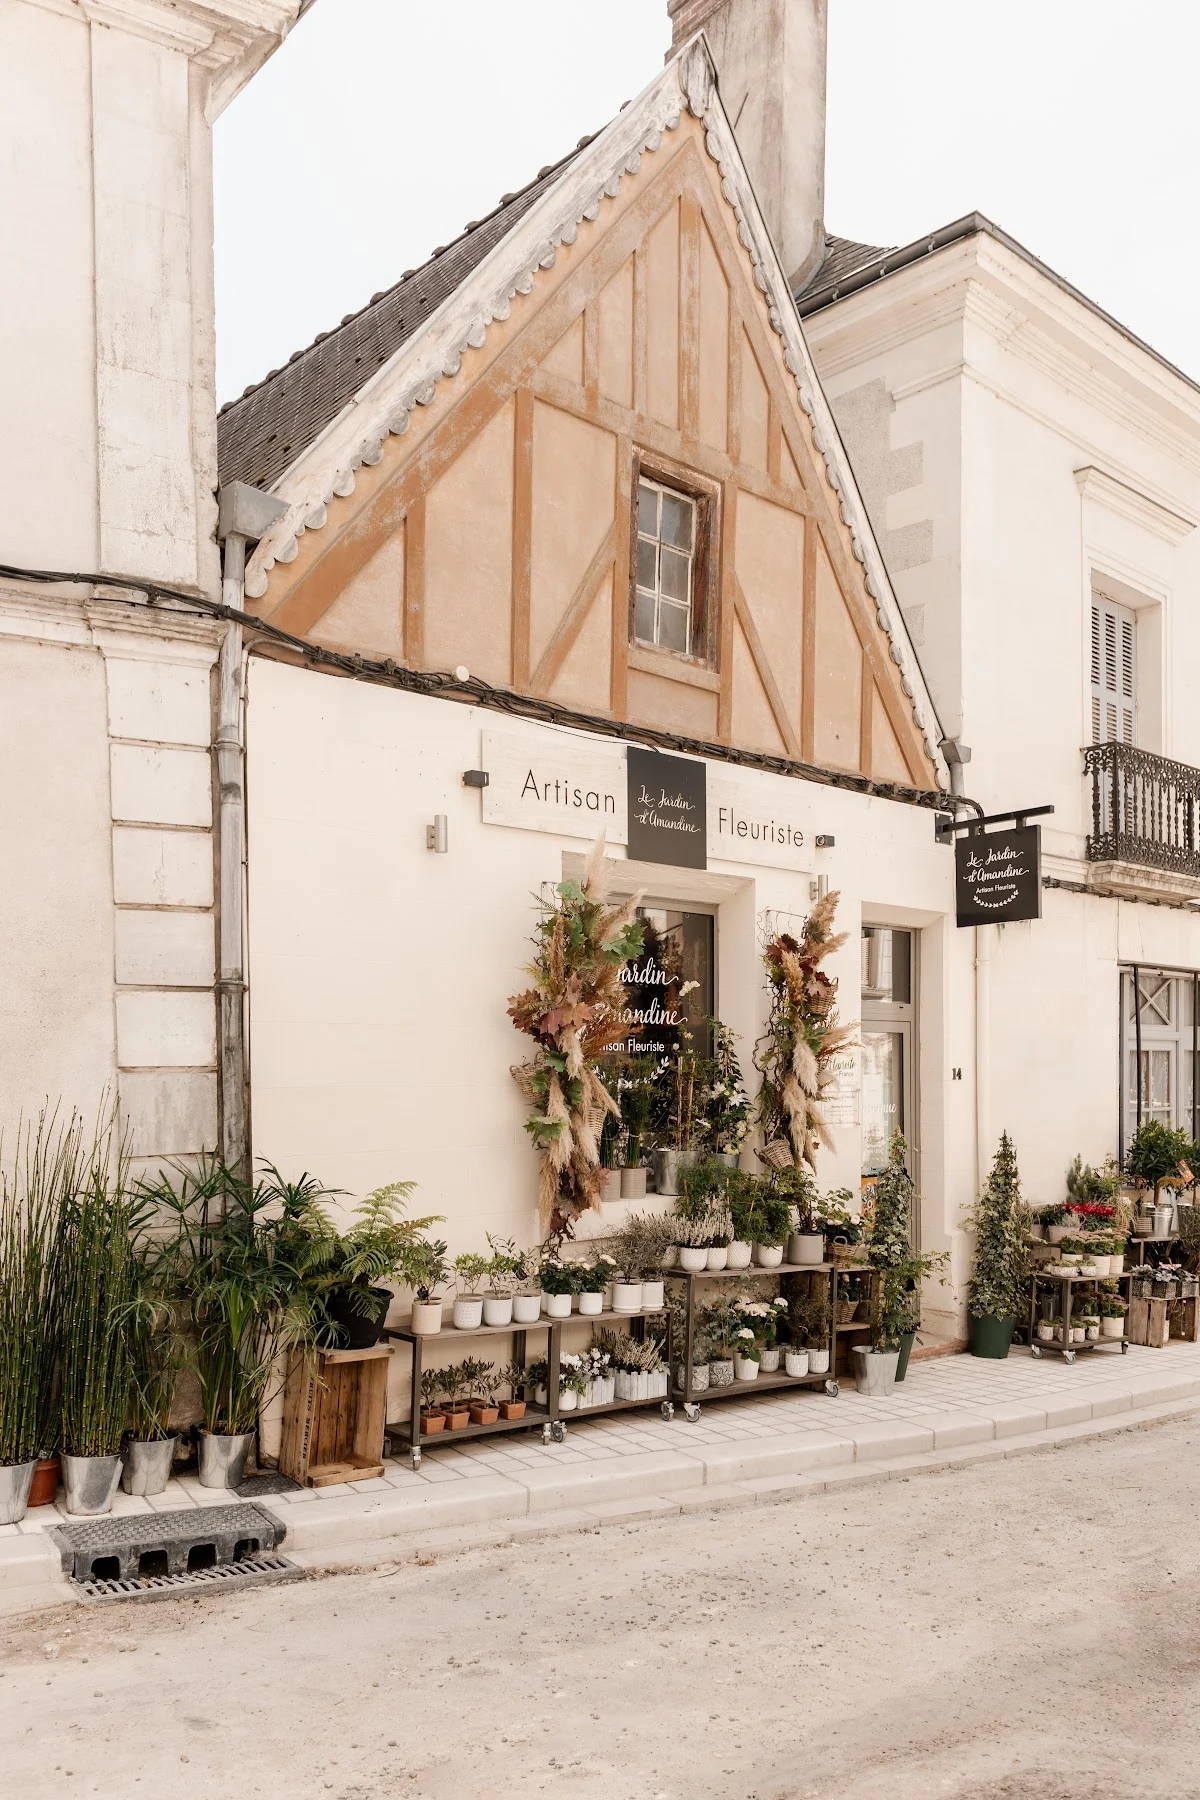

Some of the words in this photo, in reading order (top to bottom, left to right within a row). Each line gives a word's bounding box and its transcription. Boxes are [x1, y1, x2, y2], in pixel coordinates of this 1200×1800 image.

[521, 768, 616, 814] Artisan
[637, 784, 656, 808] Le
[658, 788, 696, 811] Jardin
[633, 808, 702, 833] d'Amandine
[718, 806, 805, 848] Fleuriste
[966, 851, 984, 868] Le
[985, 846, 1024, 865] Jardin
[962, 863, 1030, 883] d'Amandine
[616, 957, 679, 985] ardin
[627, 1038, 665, 1052] Fleuriste
[951, 1067, 963, 1081] 14
[303, 1417, 311, 1459] MERCIER
